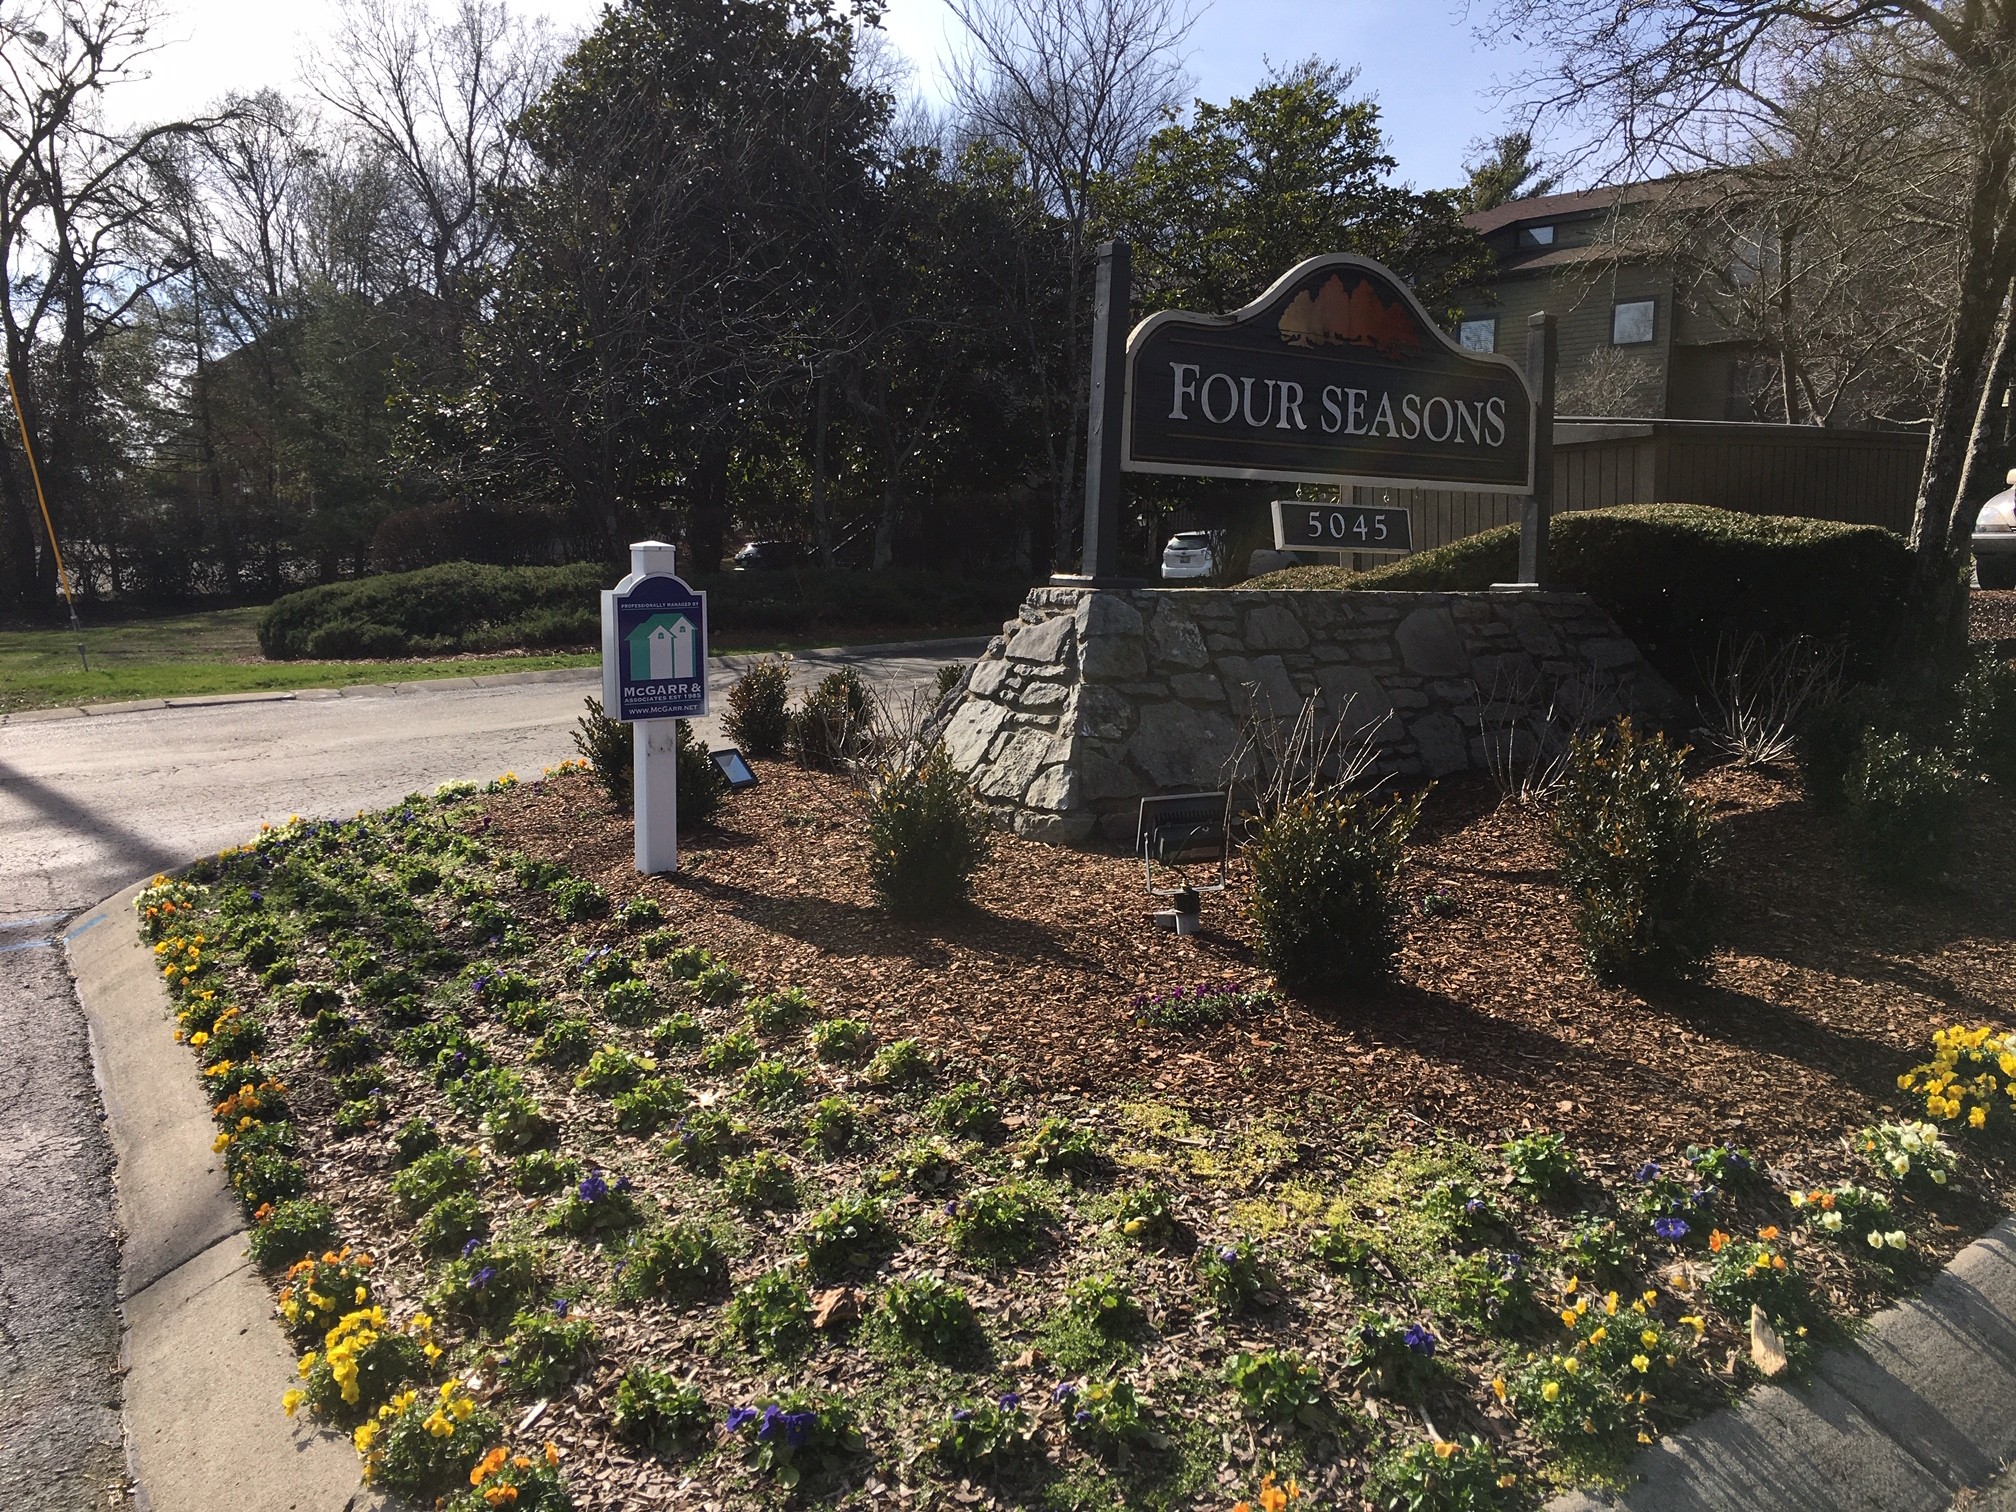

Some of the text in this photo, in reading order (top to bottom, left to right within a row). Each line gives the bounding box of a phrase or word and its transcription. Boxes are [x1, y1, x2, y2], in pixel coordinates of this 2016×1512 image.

[1168, 362, 1506, 447] FOUR SEASONS
[1308, 510, 1387, 541] 5045
[624, 683, 701, 697] McGARR &
